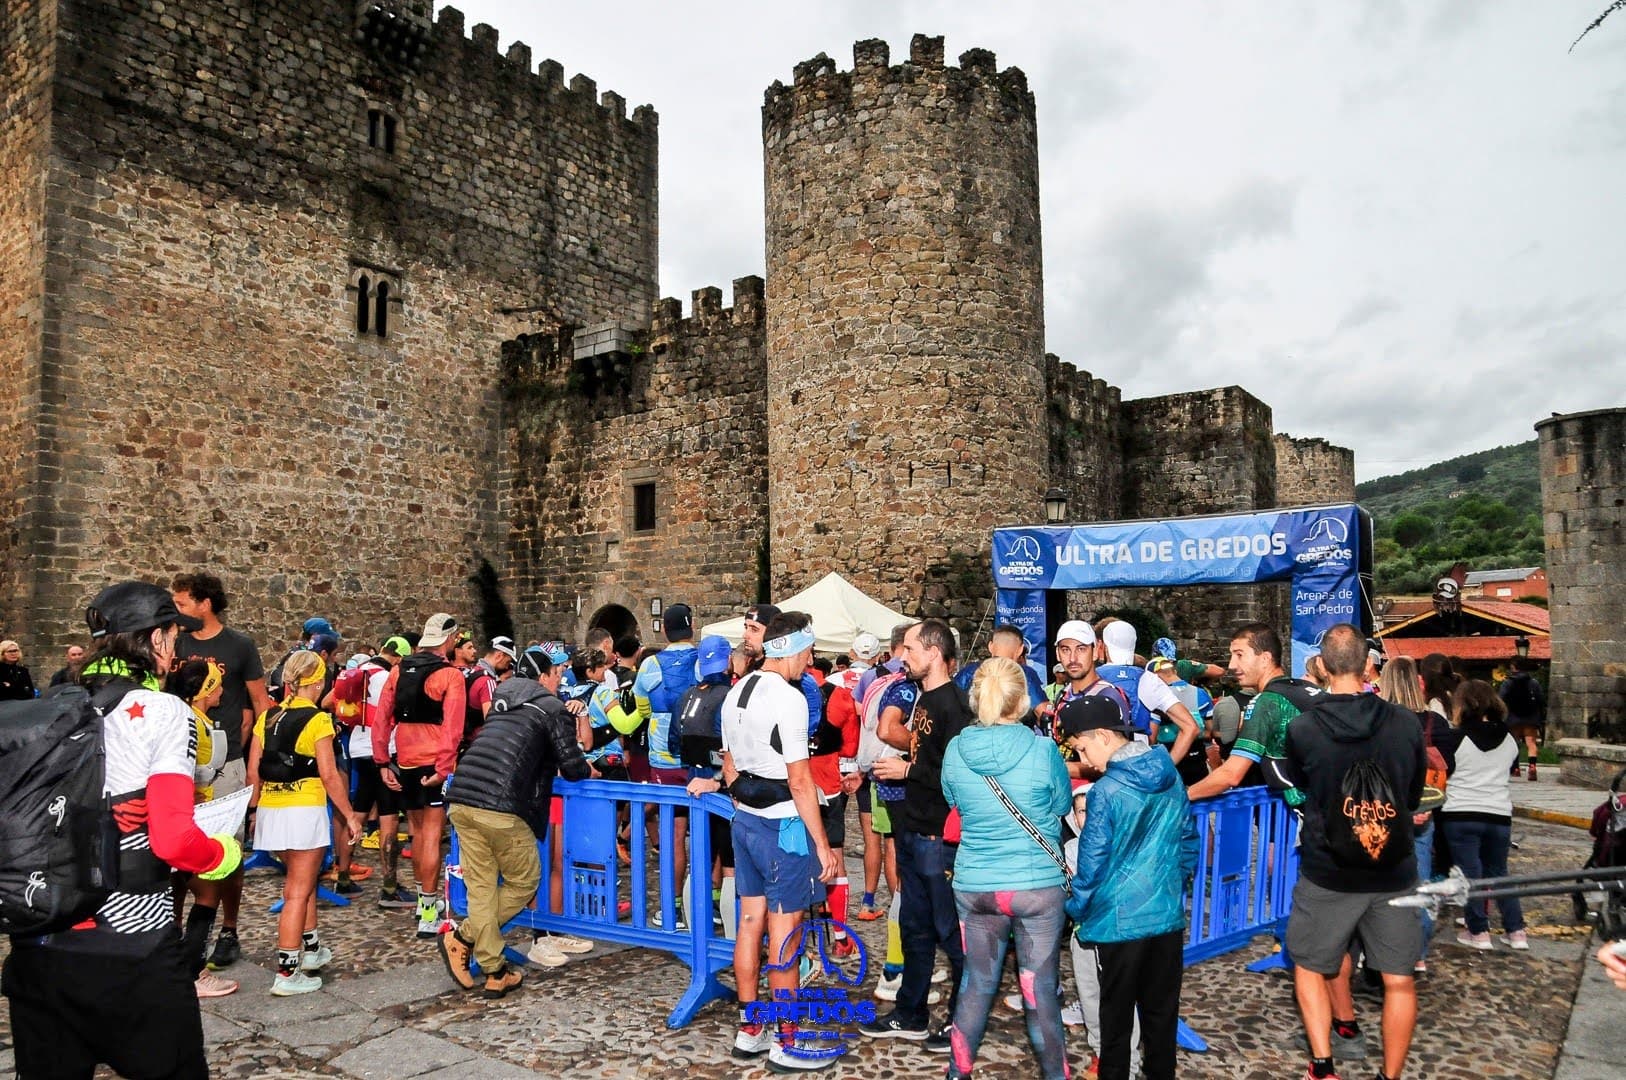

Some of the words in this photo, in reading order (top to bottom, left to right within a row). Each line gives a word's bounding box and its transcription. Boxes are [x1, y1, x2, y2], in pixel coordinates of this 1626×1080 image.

[1055, 543, 1133, 567] ULTRA
[1140, 540, 1174, 563] DE
[1180, 532, 1287, 562] GREDOS
[1295, 548, 1353, 564] GREDOS
[999, 566, 1044, 576] GREDOS
[1295, 590, 1335, 601] Arenas
[1338, 588, 1353, 600] de
[1295, 604, 1316, 616] San
[1318, 604, 1354, 615] Pedro
[1010, 616, 1036, 625] Gredos
